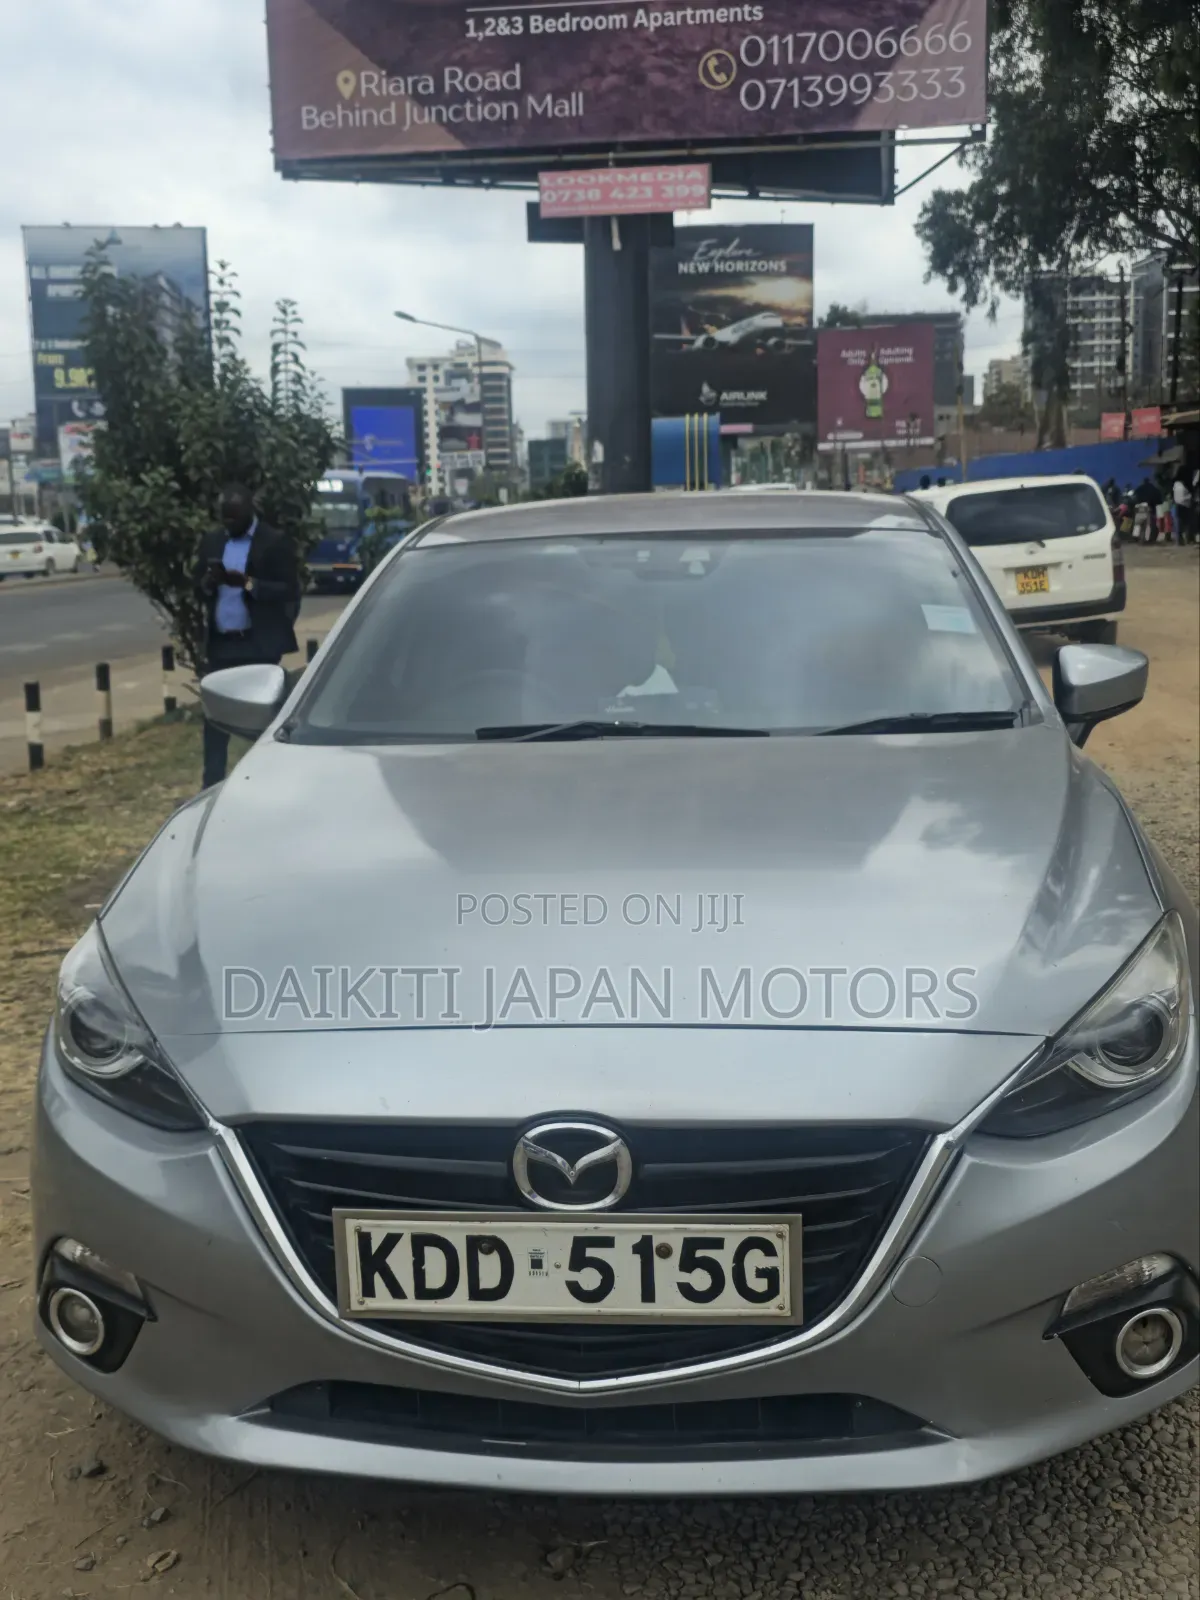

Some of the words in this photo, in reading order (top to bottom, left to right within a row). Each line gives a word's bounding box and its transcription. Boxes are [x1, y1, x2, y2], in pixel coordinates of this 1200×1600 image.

[465, 17, 524, 41] 1,2&3
[529, 12, 628, 35] Bedroom
[633, 3, 764, 33] Apartments
[739, 20, 972, 67] 0117006666
[360, 70, 435, 97] Riara
[444, 62, 521, 94] Road
[739, 66, 966, 111] 0713993333
[301, 101, 396, 131] Behind
[403, 96, 519, 131] Junction
[527, 91, 584, 119] Mall
[542, 169, 704, 187] LOOKMEDIA
[677, 261, 712, 275] NEW
[714, 260, 787, 273] HORIZONS
[693, 237, 762, 262] Explore
[359, 1231, 515, 1301] KDD
[564, 1235, 782, 1305] 515G
